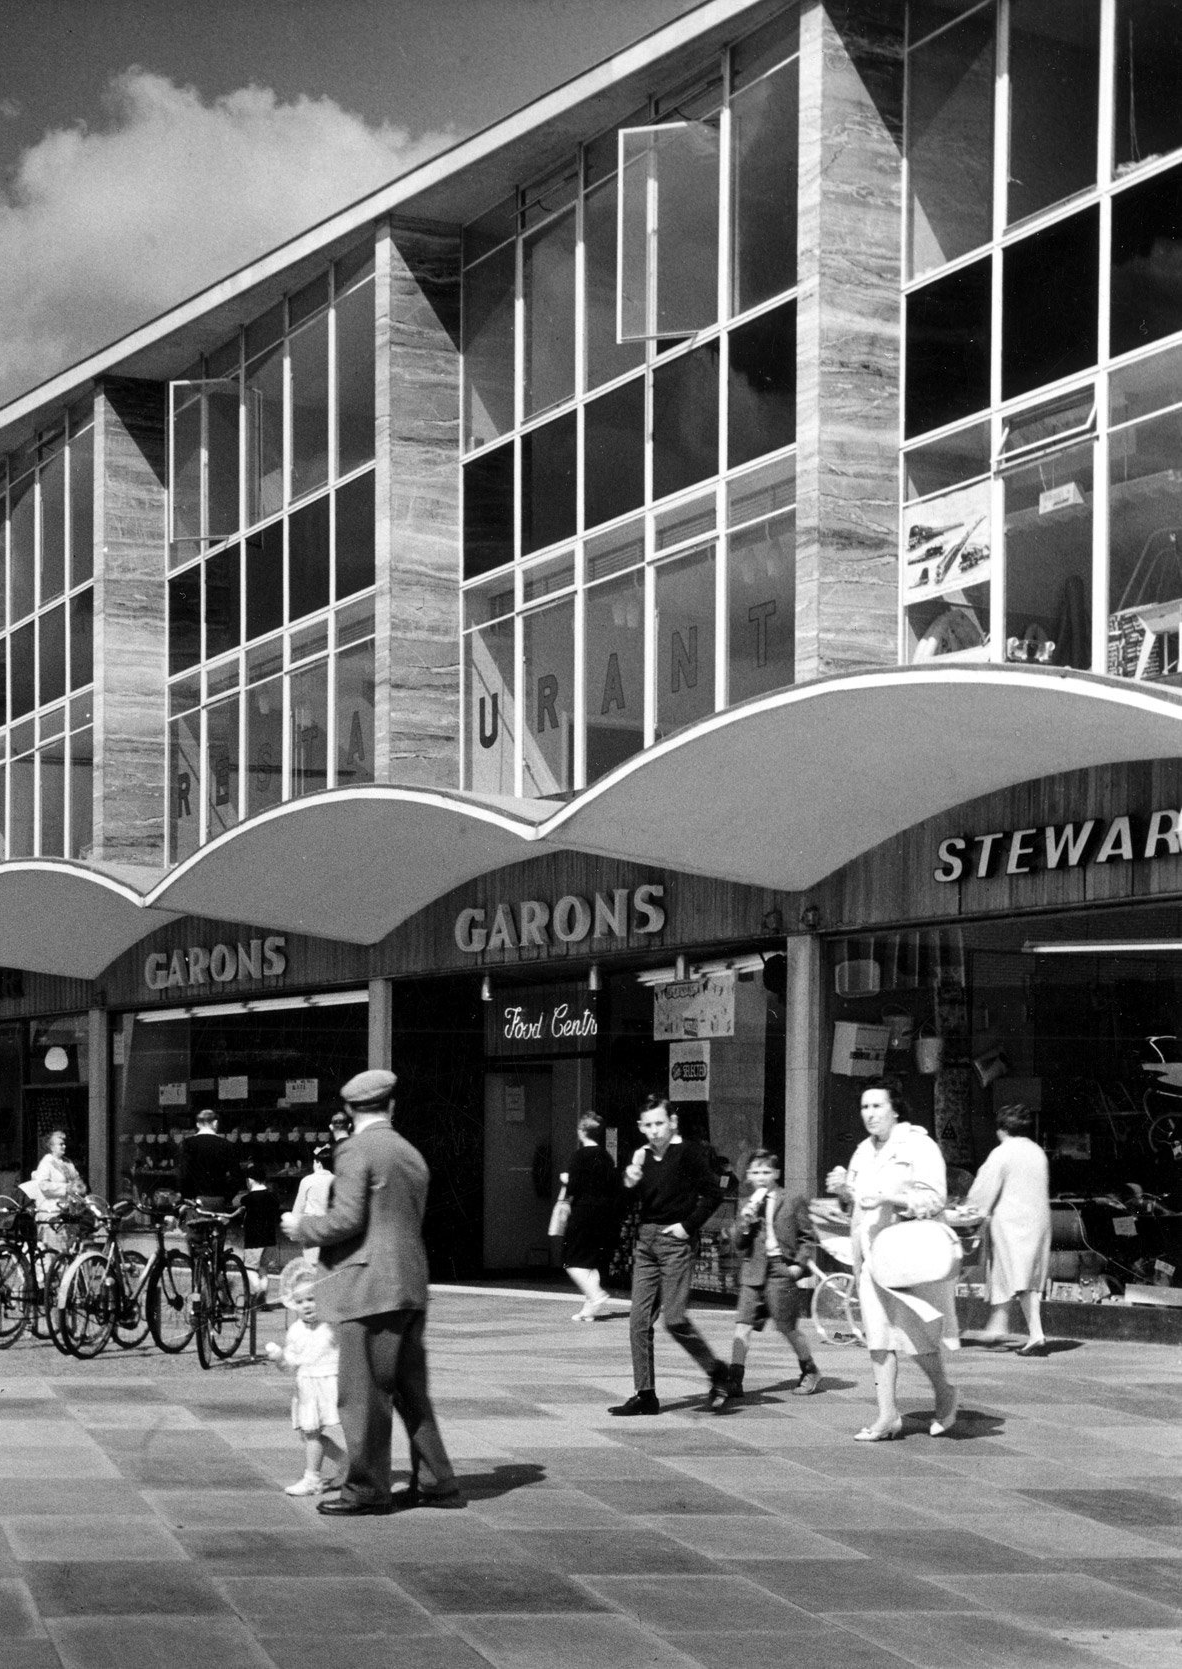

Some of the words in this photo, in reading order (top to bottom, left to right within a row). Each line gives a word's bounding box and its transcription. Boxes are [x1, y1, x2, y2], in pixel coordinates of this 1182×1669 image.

[933, 809, 1182, 882] STEWAR
[454, 884, 665, 952] GARONS
[144, 936, 285, 989] GARONS
[505, 1006, 544, 1039] Food
